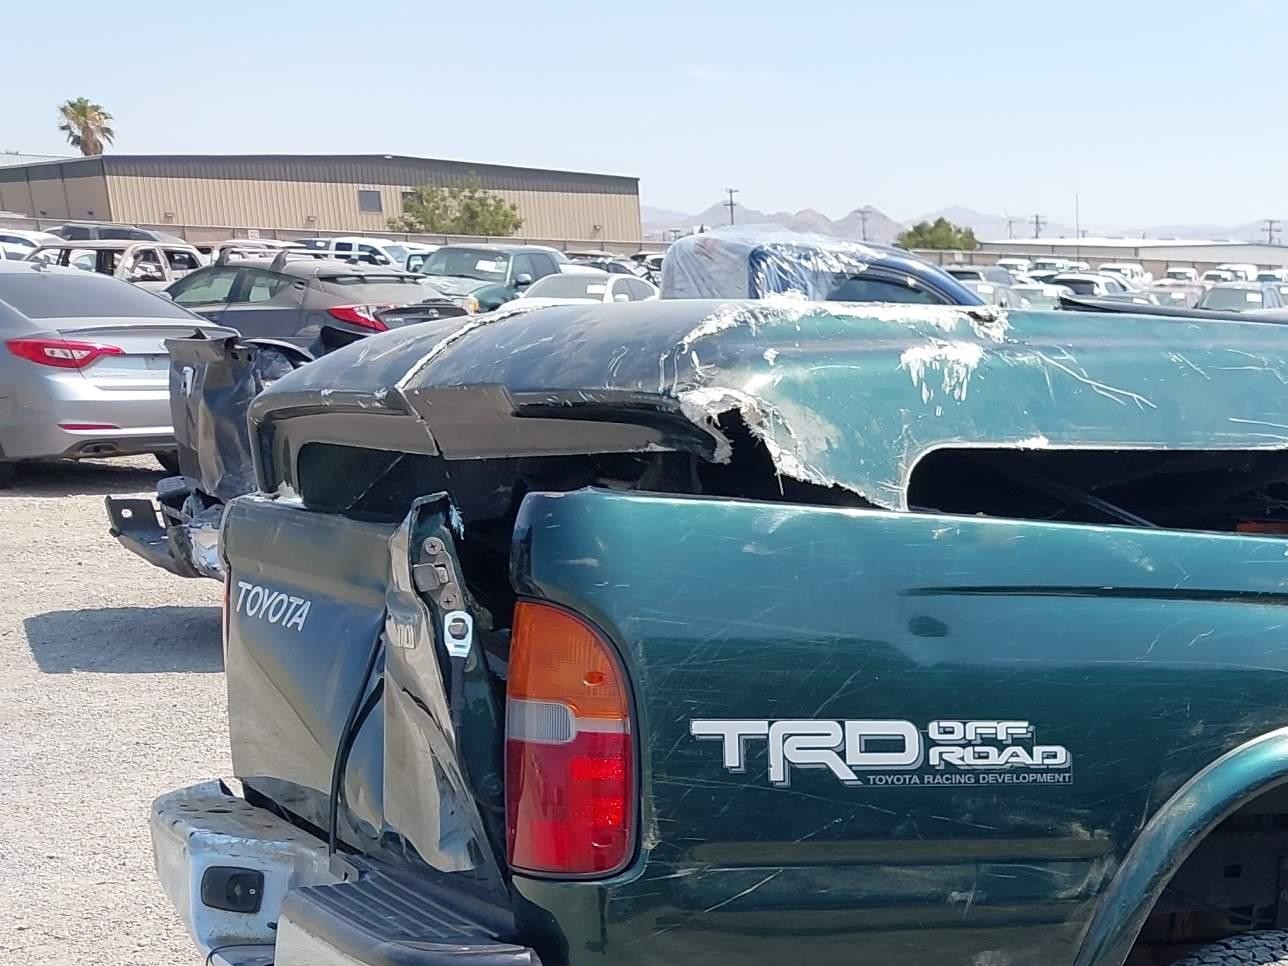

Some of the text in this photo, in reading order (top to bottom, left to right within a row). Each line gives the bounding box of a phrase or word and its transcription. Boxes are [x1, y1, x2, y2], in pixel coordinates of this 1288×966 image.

[236, 581, 311, 632] TOYOTA
[928, 720, 1035, 743] OFF
[691, 720, 923, 788] TRD
[929, 746, 1073, 769] ROAD
[867, 773, 1071, 785] TOYOTA RACING DEVELOPMENT
